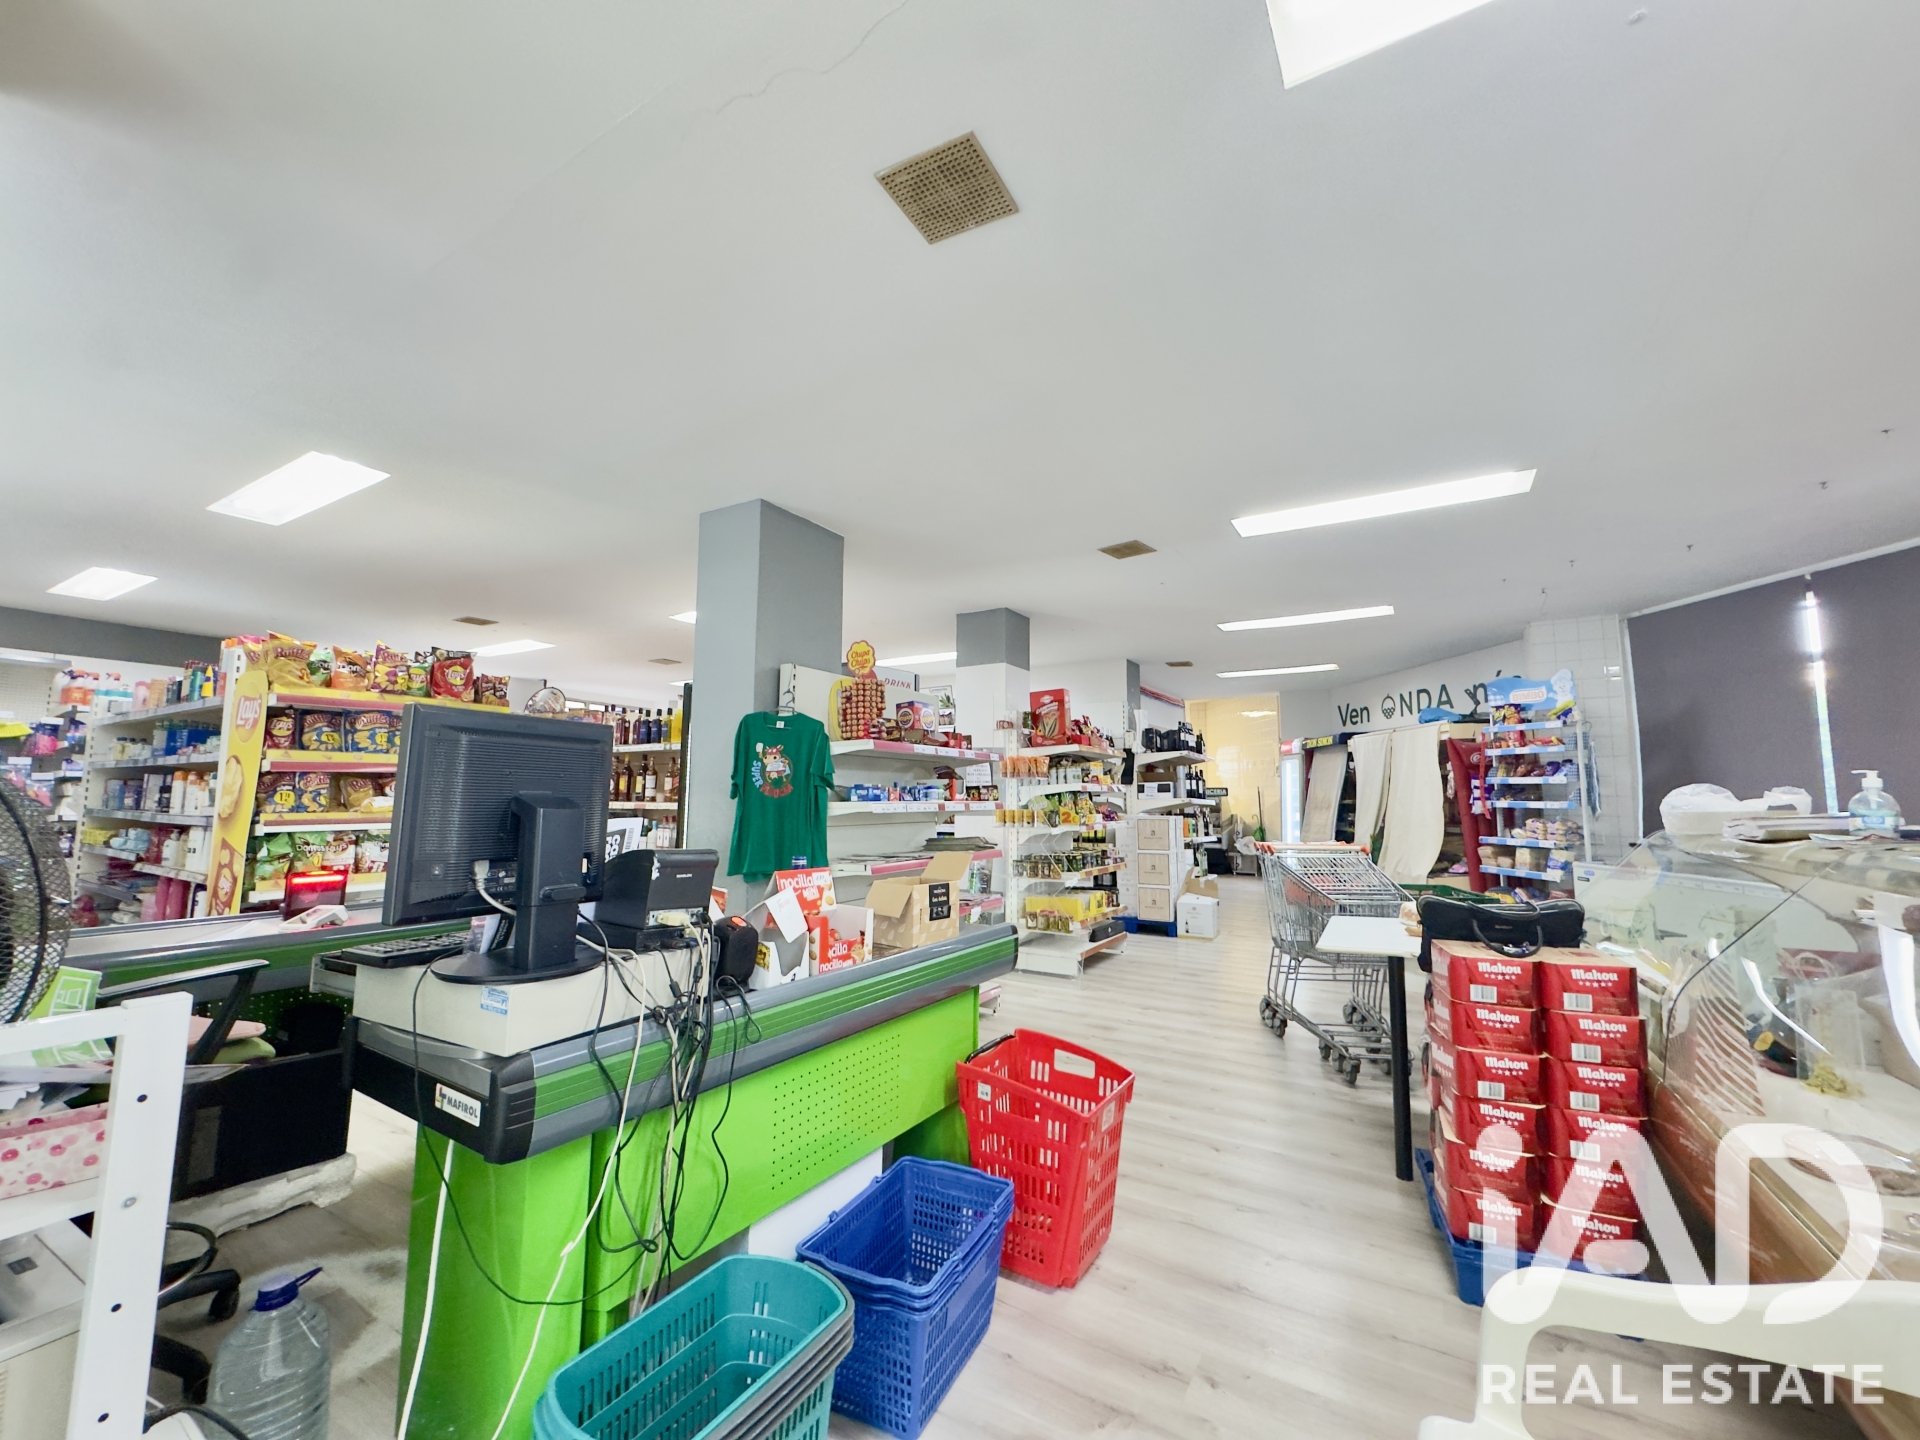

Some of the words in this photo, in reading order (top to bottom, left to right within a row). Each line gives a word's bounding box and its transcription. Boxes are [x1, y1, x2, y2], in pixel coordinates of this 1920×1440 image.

[851, 650, 870, 660] Chupa
[851, 658, 871, 668] Chups
[884, 677, 912, 691] DRINK
[236, 695, 262, 730] Lay's
[1337, 703, 1370, 727] Ven
[751, 760, 764, 789] SUPER
[780, 873, 814, 890] nocilla
[820, 959, 842, 973] nocilla
[1477, 961, 1522, 974] Mahou
[1570, 968, 1619, 981] Mahou
[1476, 1008, 1520, 1024] Mahou
[1578, 1018, 1628, 1033] Mahou
[1484, 1056, 1529, 1070] Mahou
[1577, 1066, 1627, 1082] Mahou
[446, 1095, 479, 1119] MAFIROL
[1479, 1103, 1525, 1121] Mahou
[1577, 1115, 1627, 1133] Mahou
[1469, 1149, 1518, 1169] Mahou
[1574, 1164, 1624, 1184] Mahou
[1476, 1198, 1523, 1217] Mahou
[1571, 1214, 1621, 1235] Mahou
